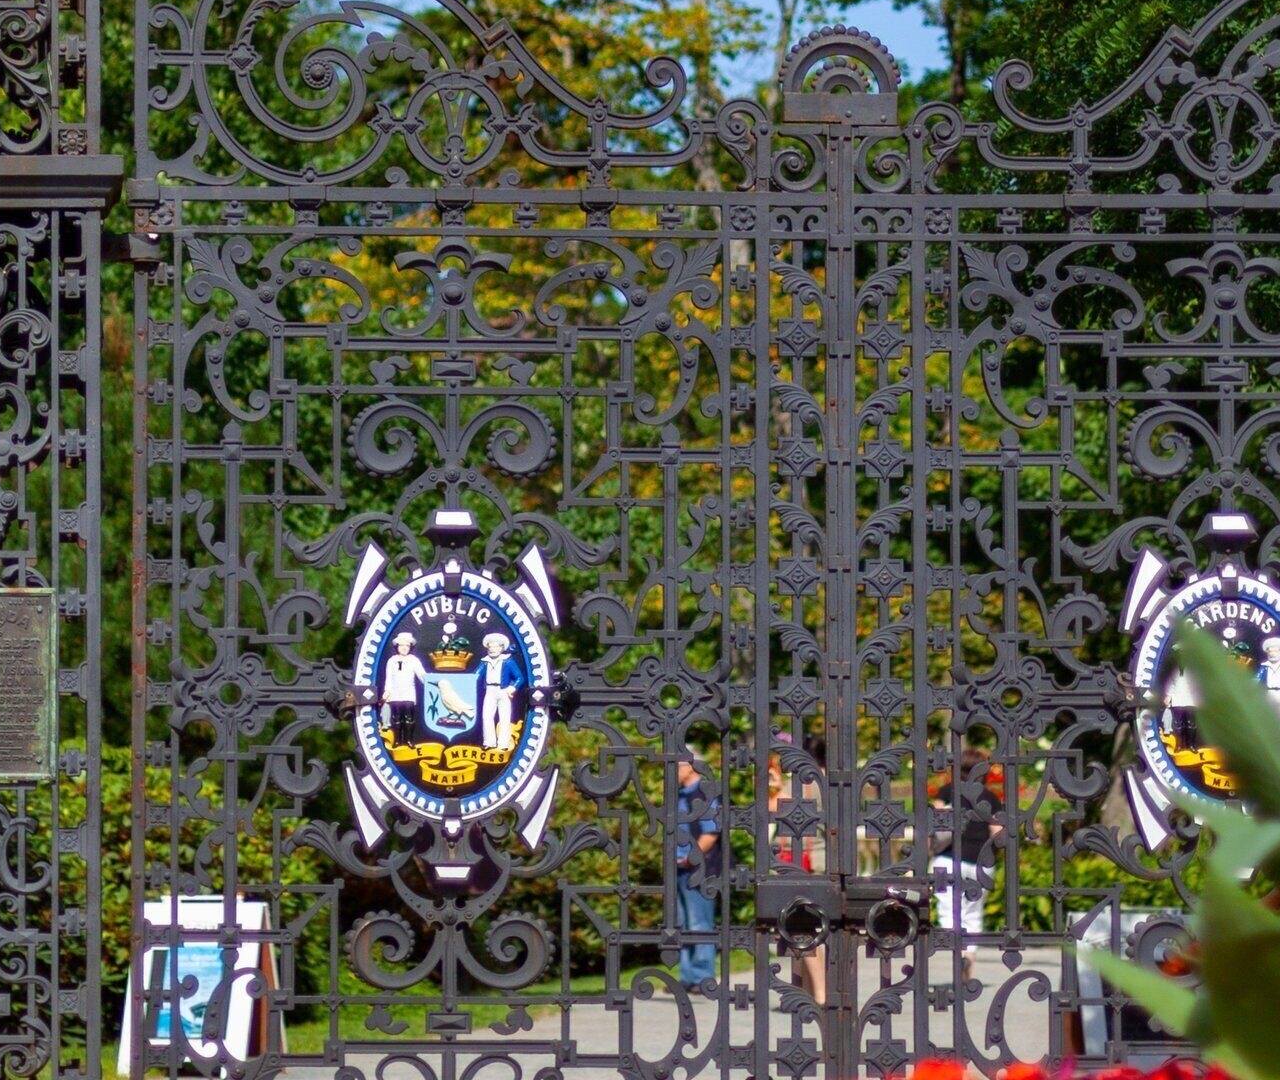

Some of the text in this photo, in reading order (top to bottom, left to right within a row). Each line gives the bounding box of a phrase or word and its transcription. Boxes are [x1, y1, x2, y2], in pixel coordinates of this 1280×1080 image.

[410, 596, 491, 625] PUBLIC
[416, 748, 423, 756] E
[430, 773, 465, 783] MARI
